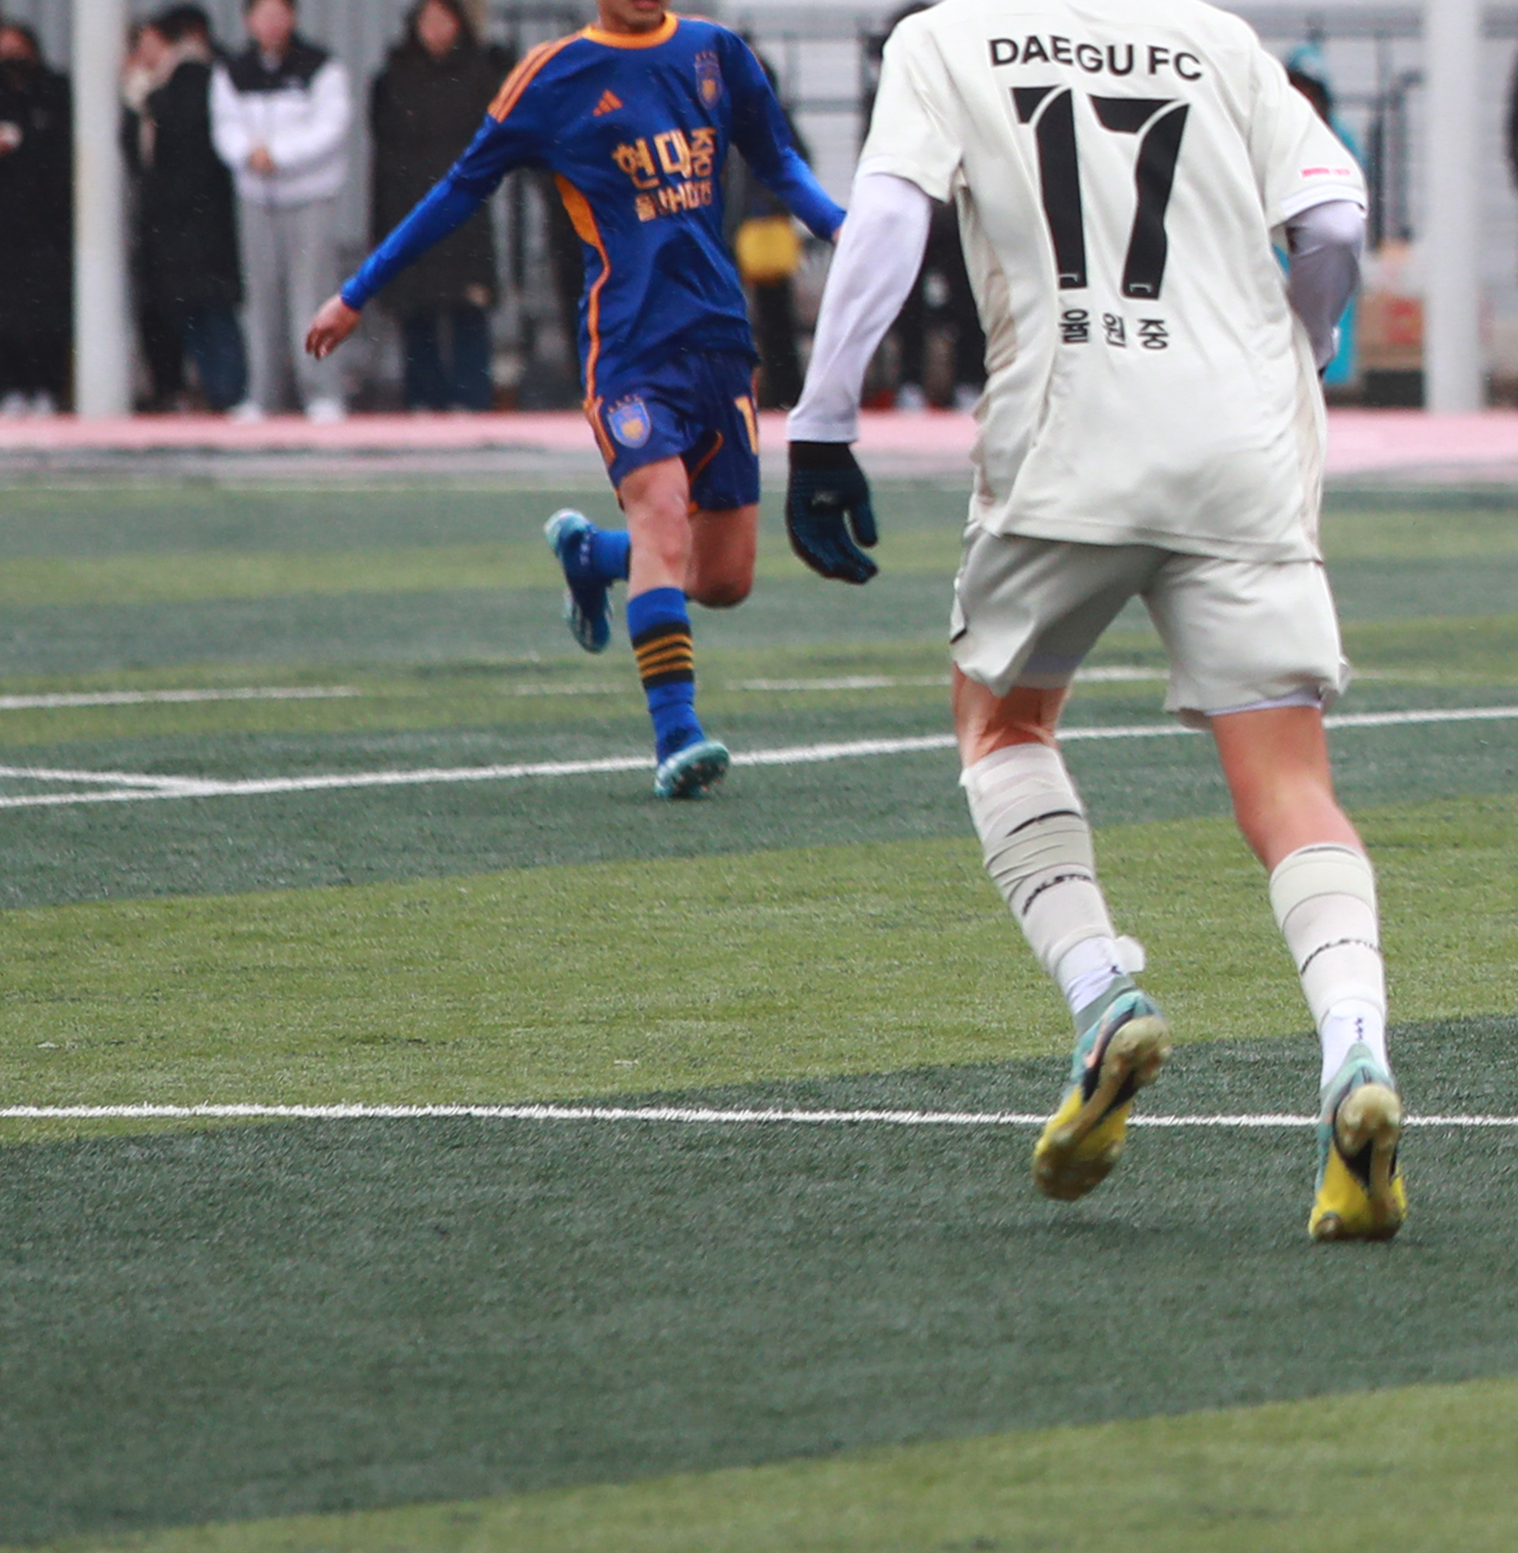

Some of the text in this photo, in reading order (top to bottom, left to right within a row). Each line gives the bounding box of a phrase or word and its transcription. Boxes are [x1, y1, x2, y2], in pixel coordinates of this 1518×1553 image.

[989, 35, 1203, 81] DAEGU FC
[1010, 85, 1190, 300] 17
[1058, 309, 1168, 350] 율원중
